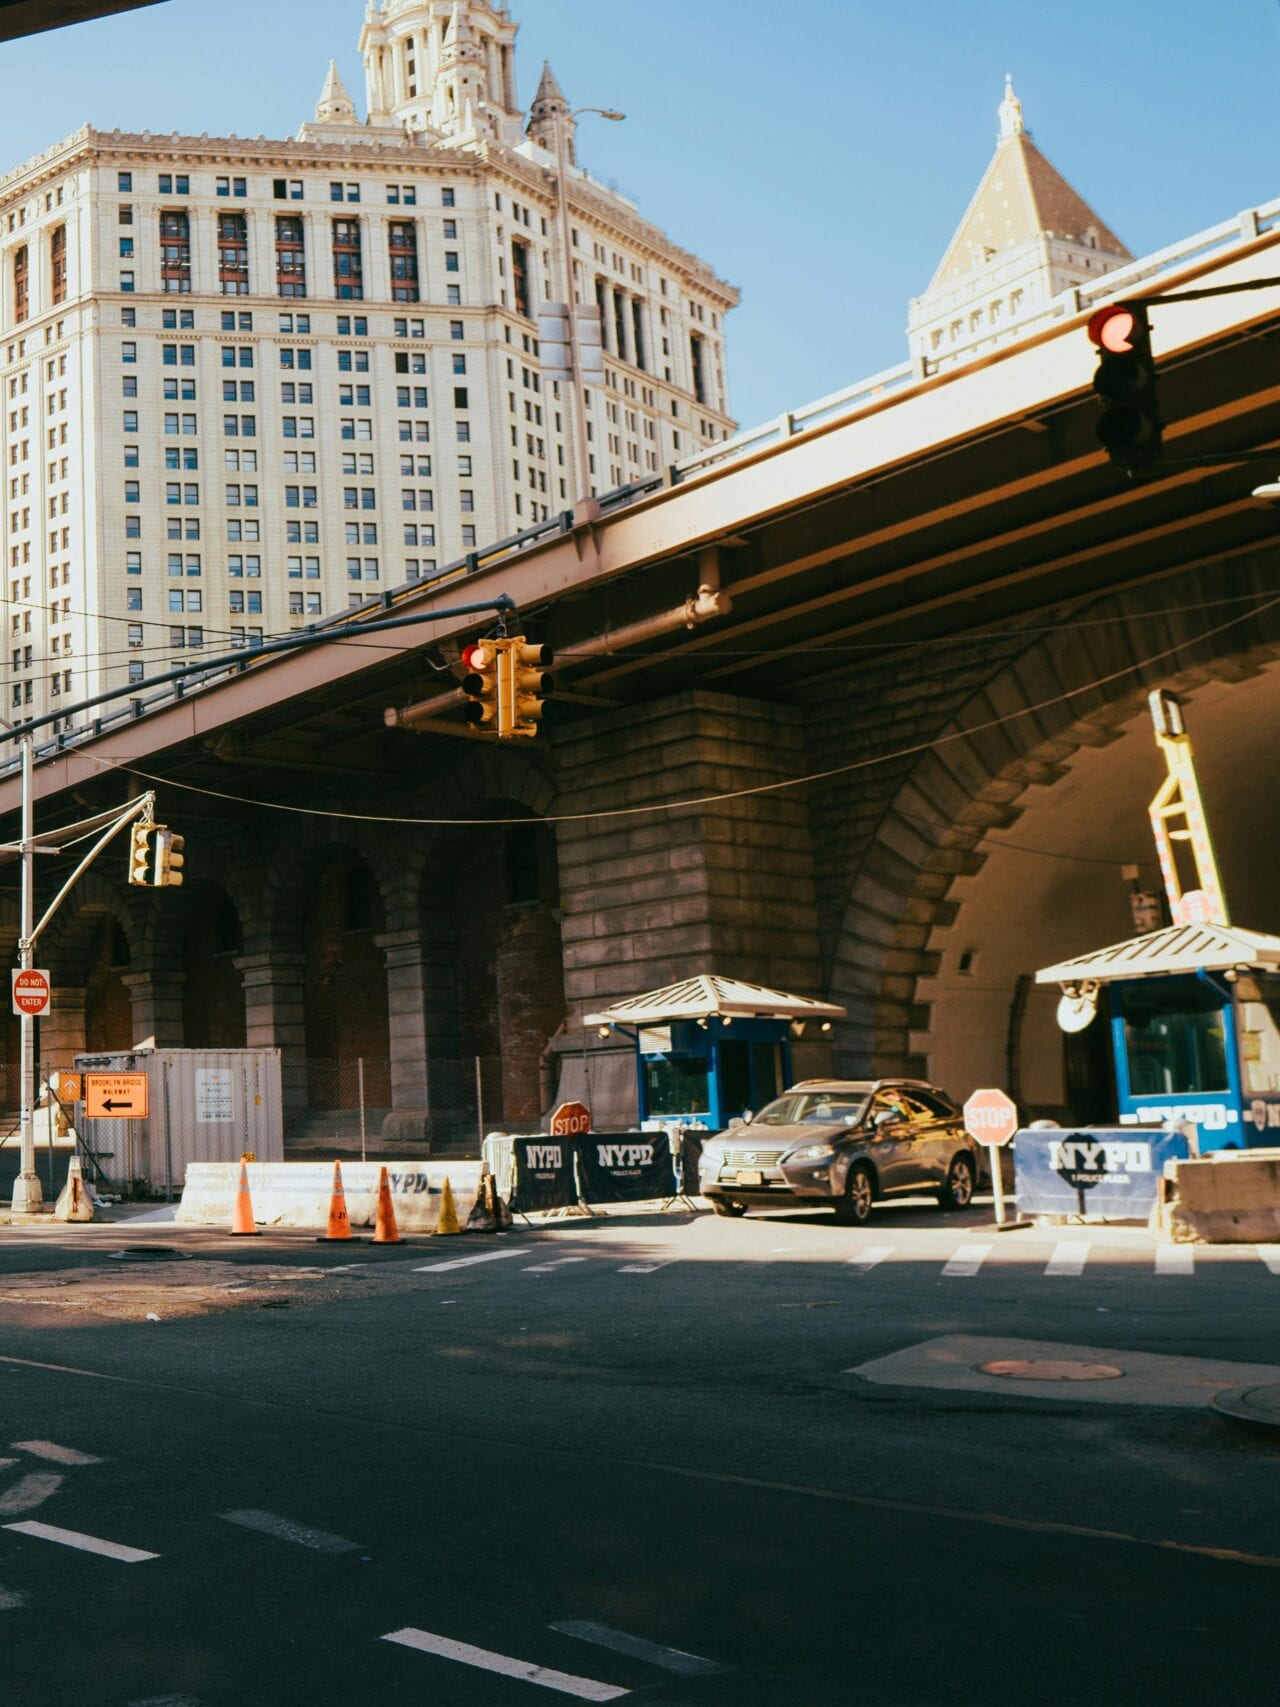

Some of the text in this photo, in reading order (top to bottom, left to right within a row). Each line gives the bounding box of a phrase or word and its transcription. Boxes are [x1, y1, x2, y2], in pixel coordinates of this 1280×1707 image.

[19, 978, 43, 987] DO NOT
[21, 998, 42, 1006] ENTER
[103, 1088, 130, 1096] WALKWAY
[555, 1115, 588, 1135] STOP
[970, 1106, 1011, 1129] STOP
[526, 1145, 562, 1168] NYPD
[597, 1145, 654, 1167] NYPD
[1048, 1141, 1151, 1172] NYPD
[386, 1173, 428, 1194] YPD
